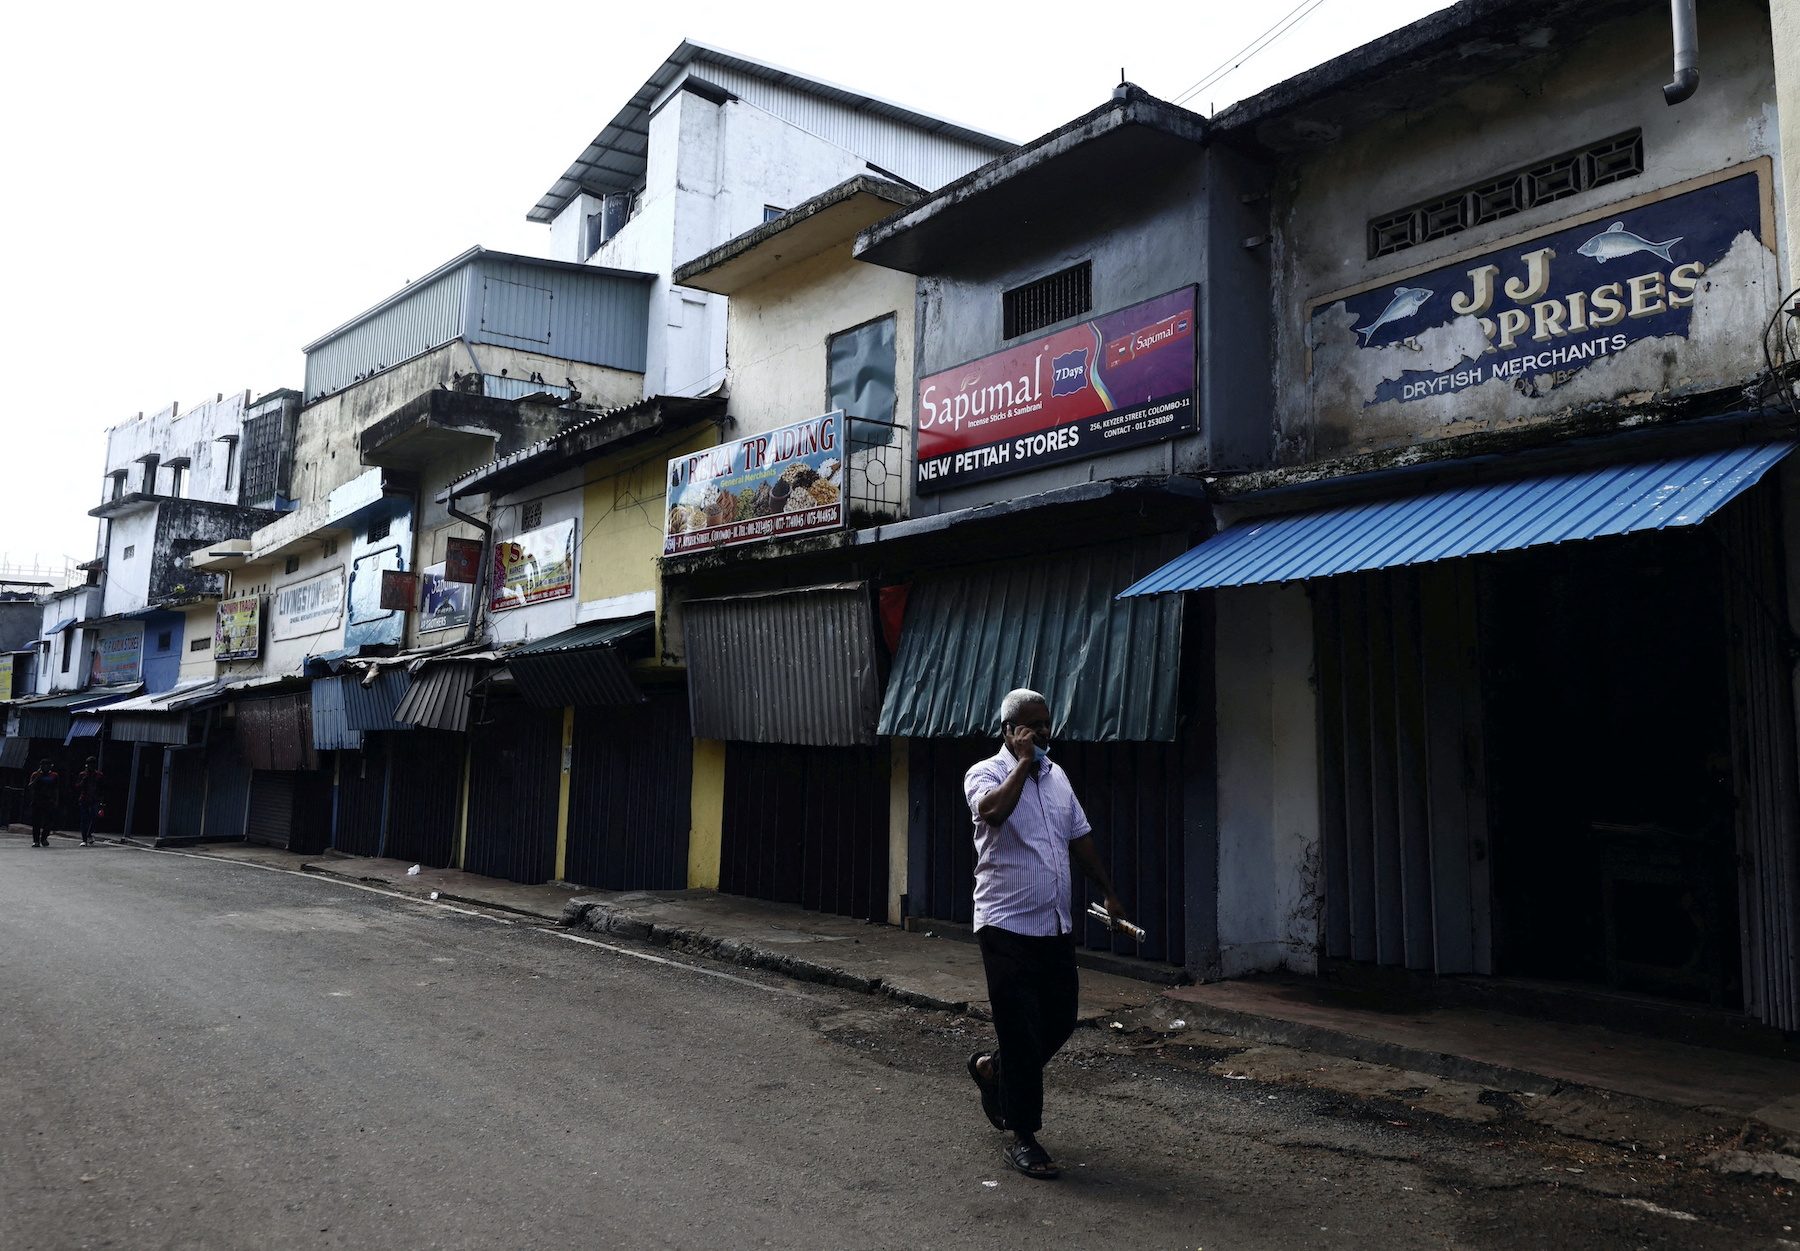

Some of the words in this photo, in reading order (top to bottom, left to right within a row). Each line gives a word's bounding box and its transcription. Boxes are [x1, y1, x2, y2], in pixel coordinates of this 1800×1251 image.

[1136, 320, 1176, 350] Sapumal
[1403, 367, 1482, 400] DRYFISH
[1492, 333, 1628, 378] MERCHANTS
[920, 354, 1042, 431] Sapumal
[967, 418, 989, 429] Incense
[989, 411, 1007, 423] Sticks
[1007, 410, 1013, 419] &
[1013, 401, 1043, 417] Sambrani
[1102, 416, 1124, 428] KEYZER
[1104, 423, 1131, 439] CONTACT
[1135, 420, 1147, 431] 011
[1147, 413, 1174, 428] 2530269
[743, 418, 835, 471] TRADING
[918, 456, 951, 482] NEW
[955, 443, 1010, 474] PETTAH
[1014, 425, 1080, 460] STORES
[720, 474, 744, 488] General
[745, 468, 777, 484] Merchants
[279, 581, 321, 616] LIVINGSTON
